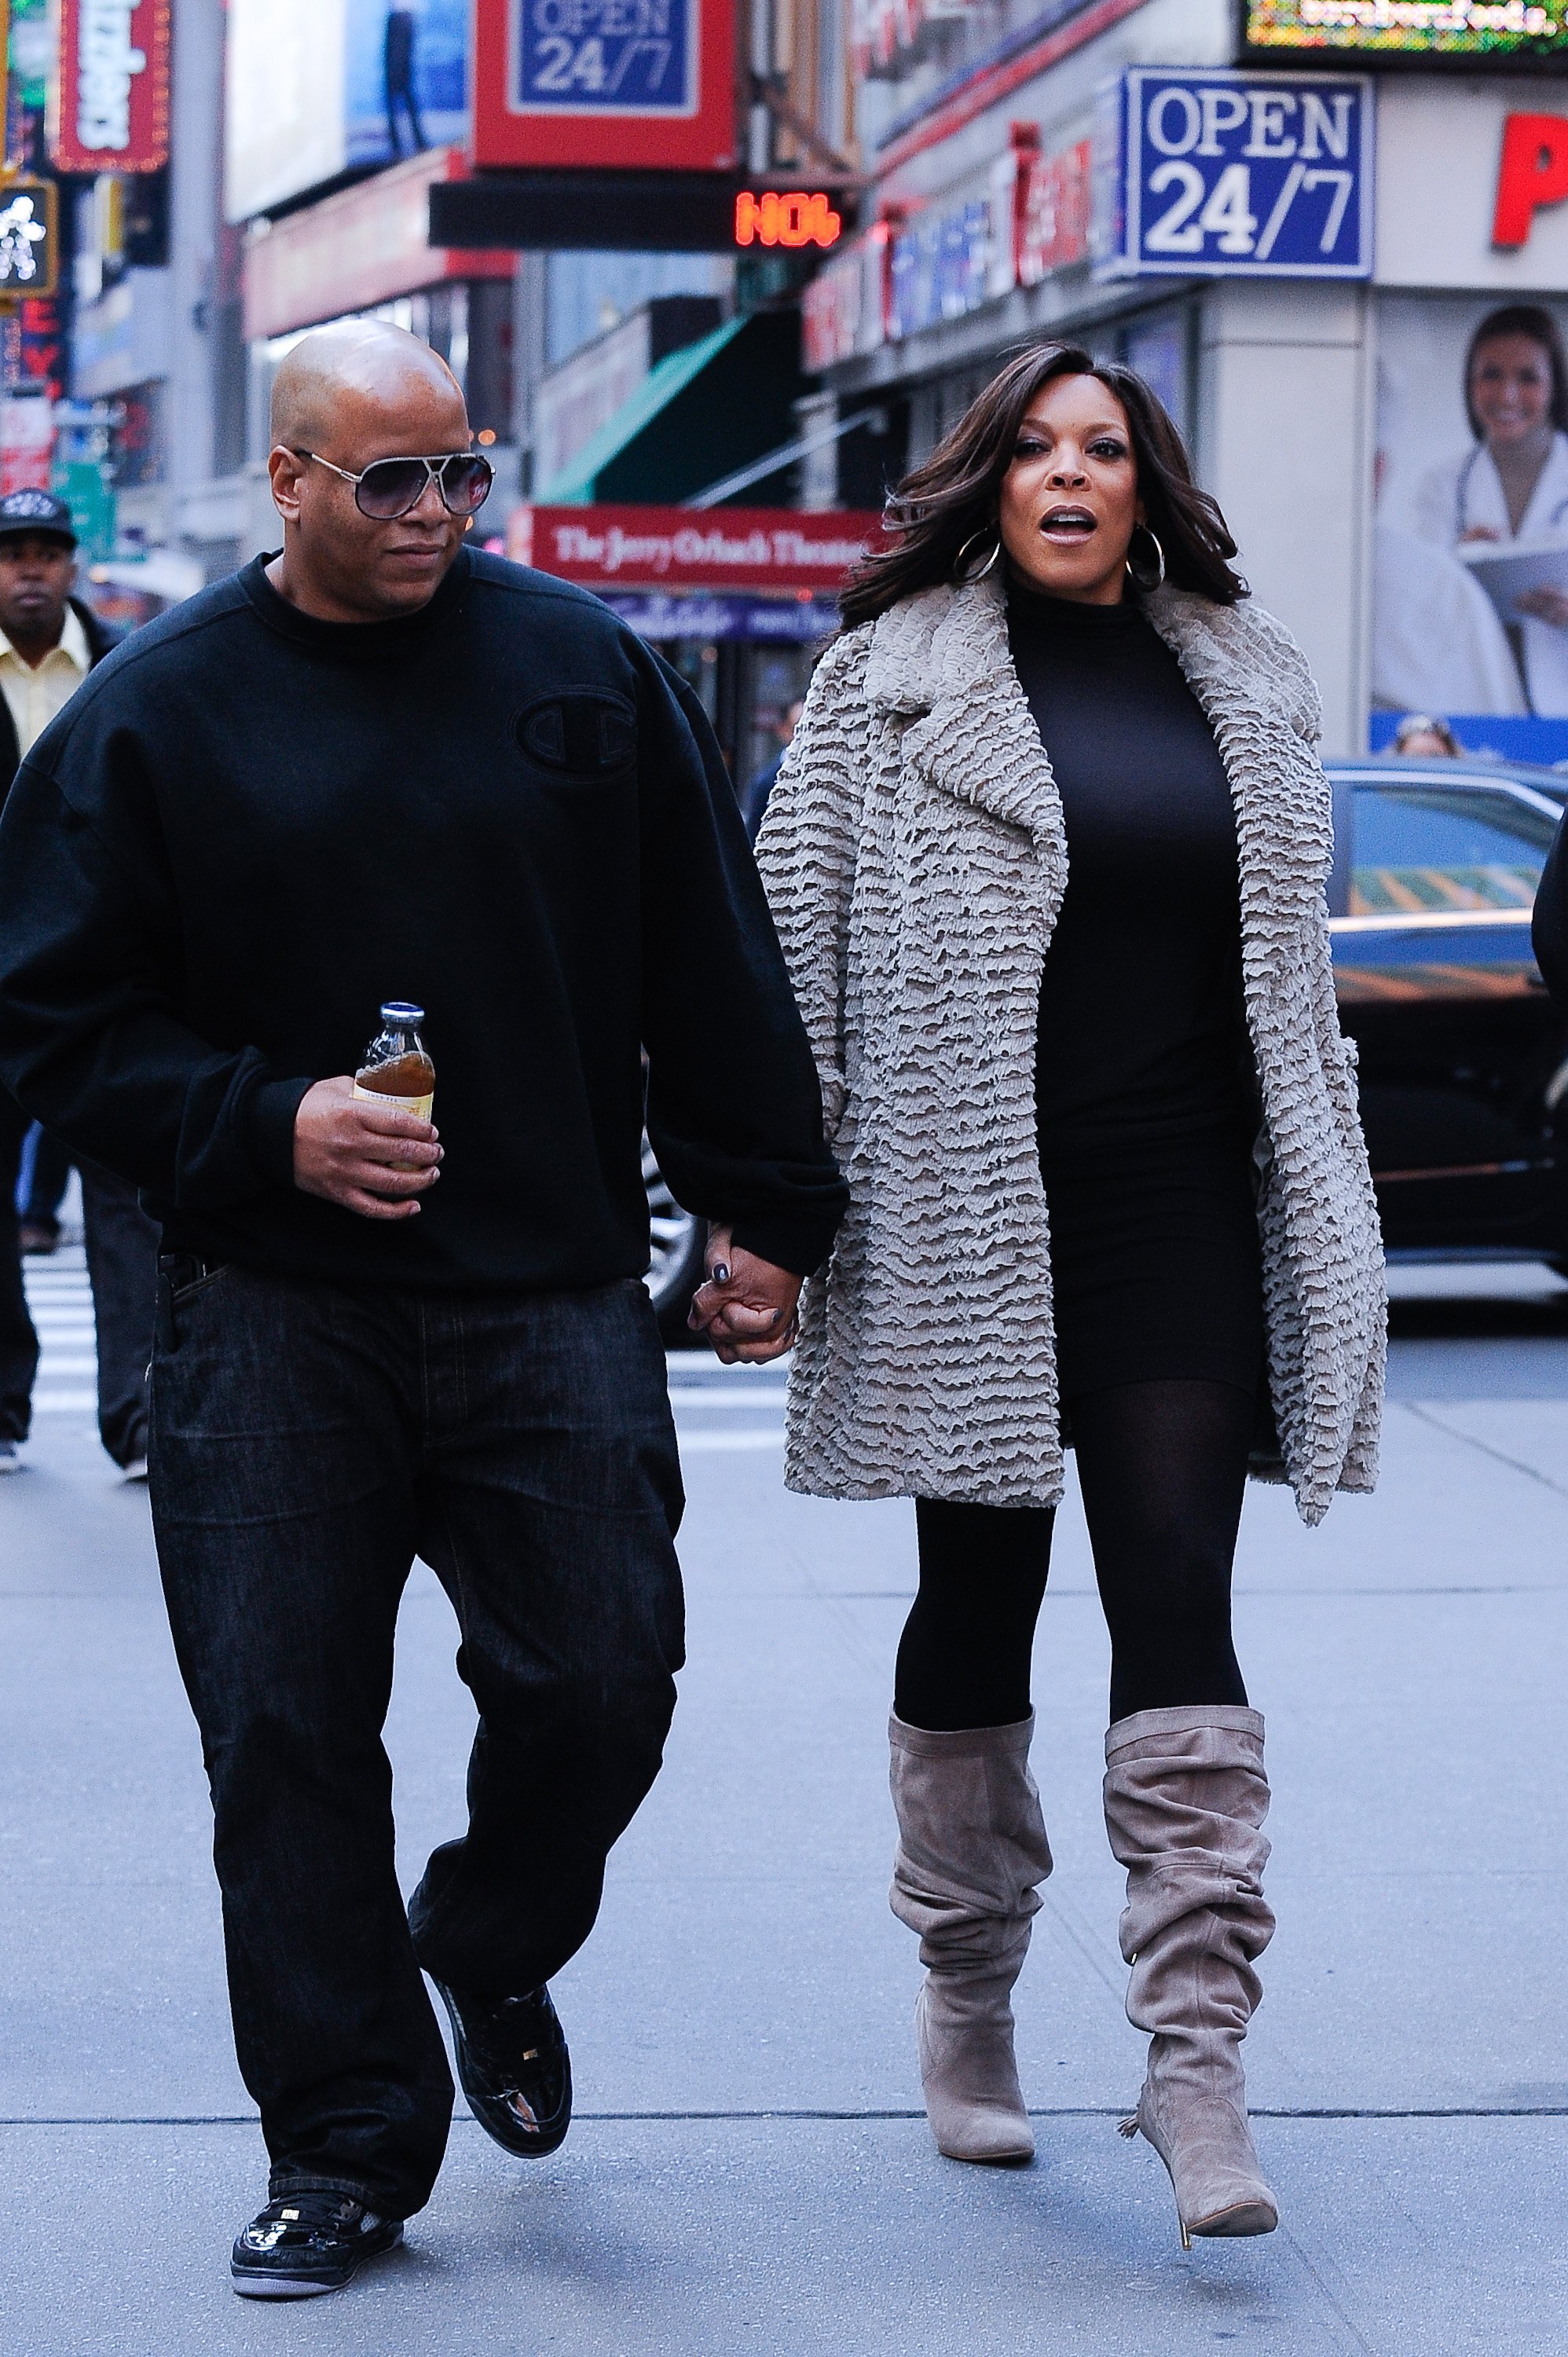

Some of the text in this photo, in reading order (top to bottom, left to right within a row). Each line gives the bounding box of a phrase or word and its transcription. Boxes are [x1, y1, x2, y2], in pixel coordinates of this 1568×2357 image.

[532, 0, 670, 35] OPEN
[533, 37, 672, 94] 24/7
[1147, 87, 1353, 159] OPEN
[1145, 161, 1354, 260] 24/7
[554, 526, 604, 562] The
